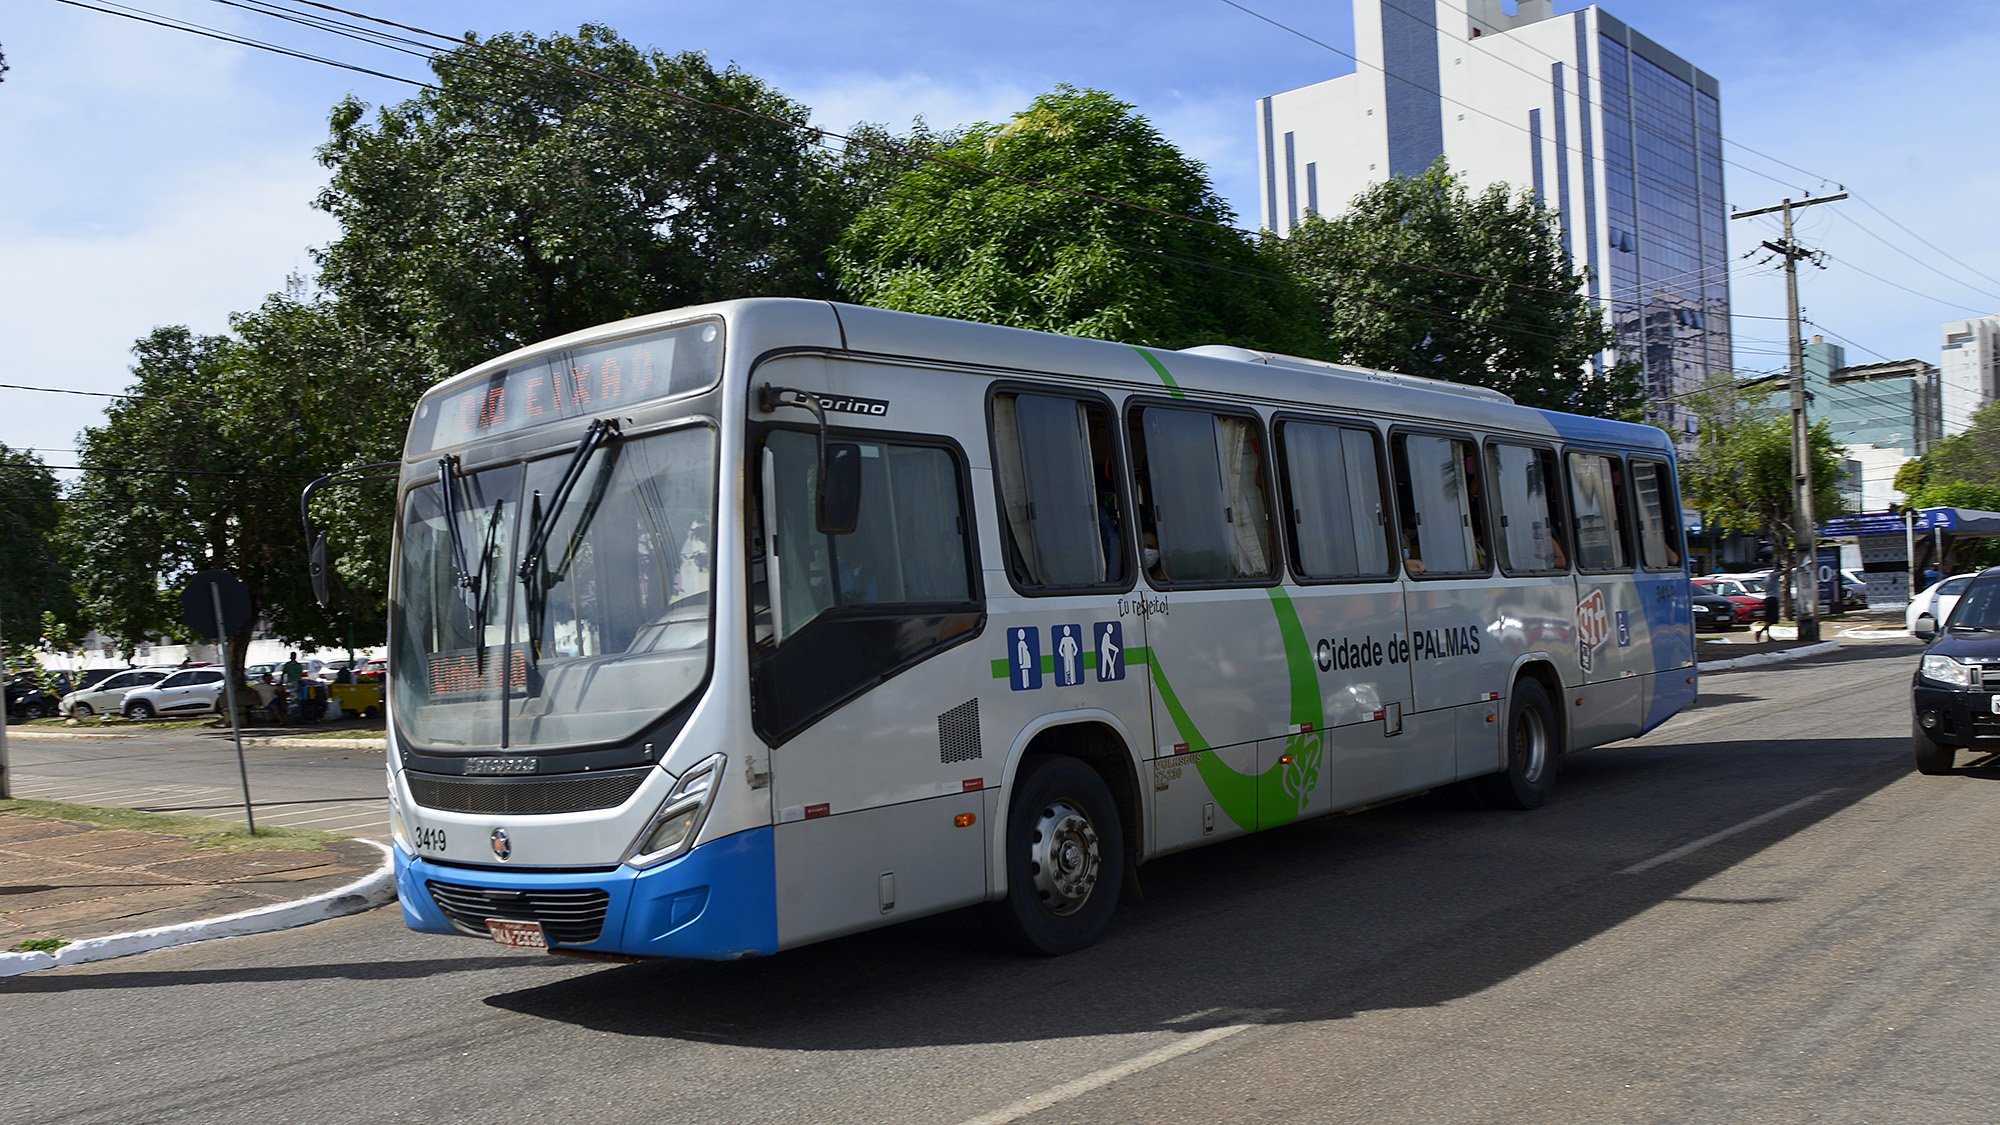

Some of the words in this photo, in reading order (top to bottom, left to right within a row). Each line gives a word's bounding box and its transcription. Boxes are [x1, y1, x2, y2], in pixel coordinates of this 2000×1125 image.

[460, 386, 506, 432] 010
[1316, 638, 1383, 672] Cidade
[1388, 633, 1409, 664] de
[1413, 625, 1480, 661] PALMAS
[1155, 753, 1202, 770] VOLKSBUS
[415, 826, 447, 852] 341-9
